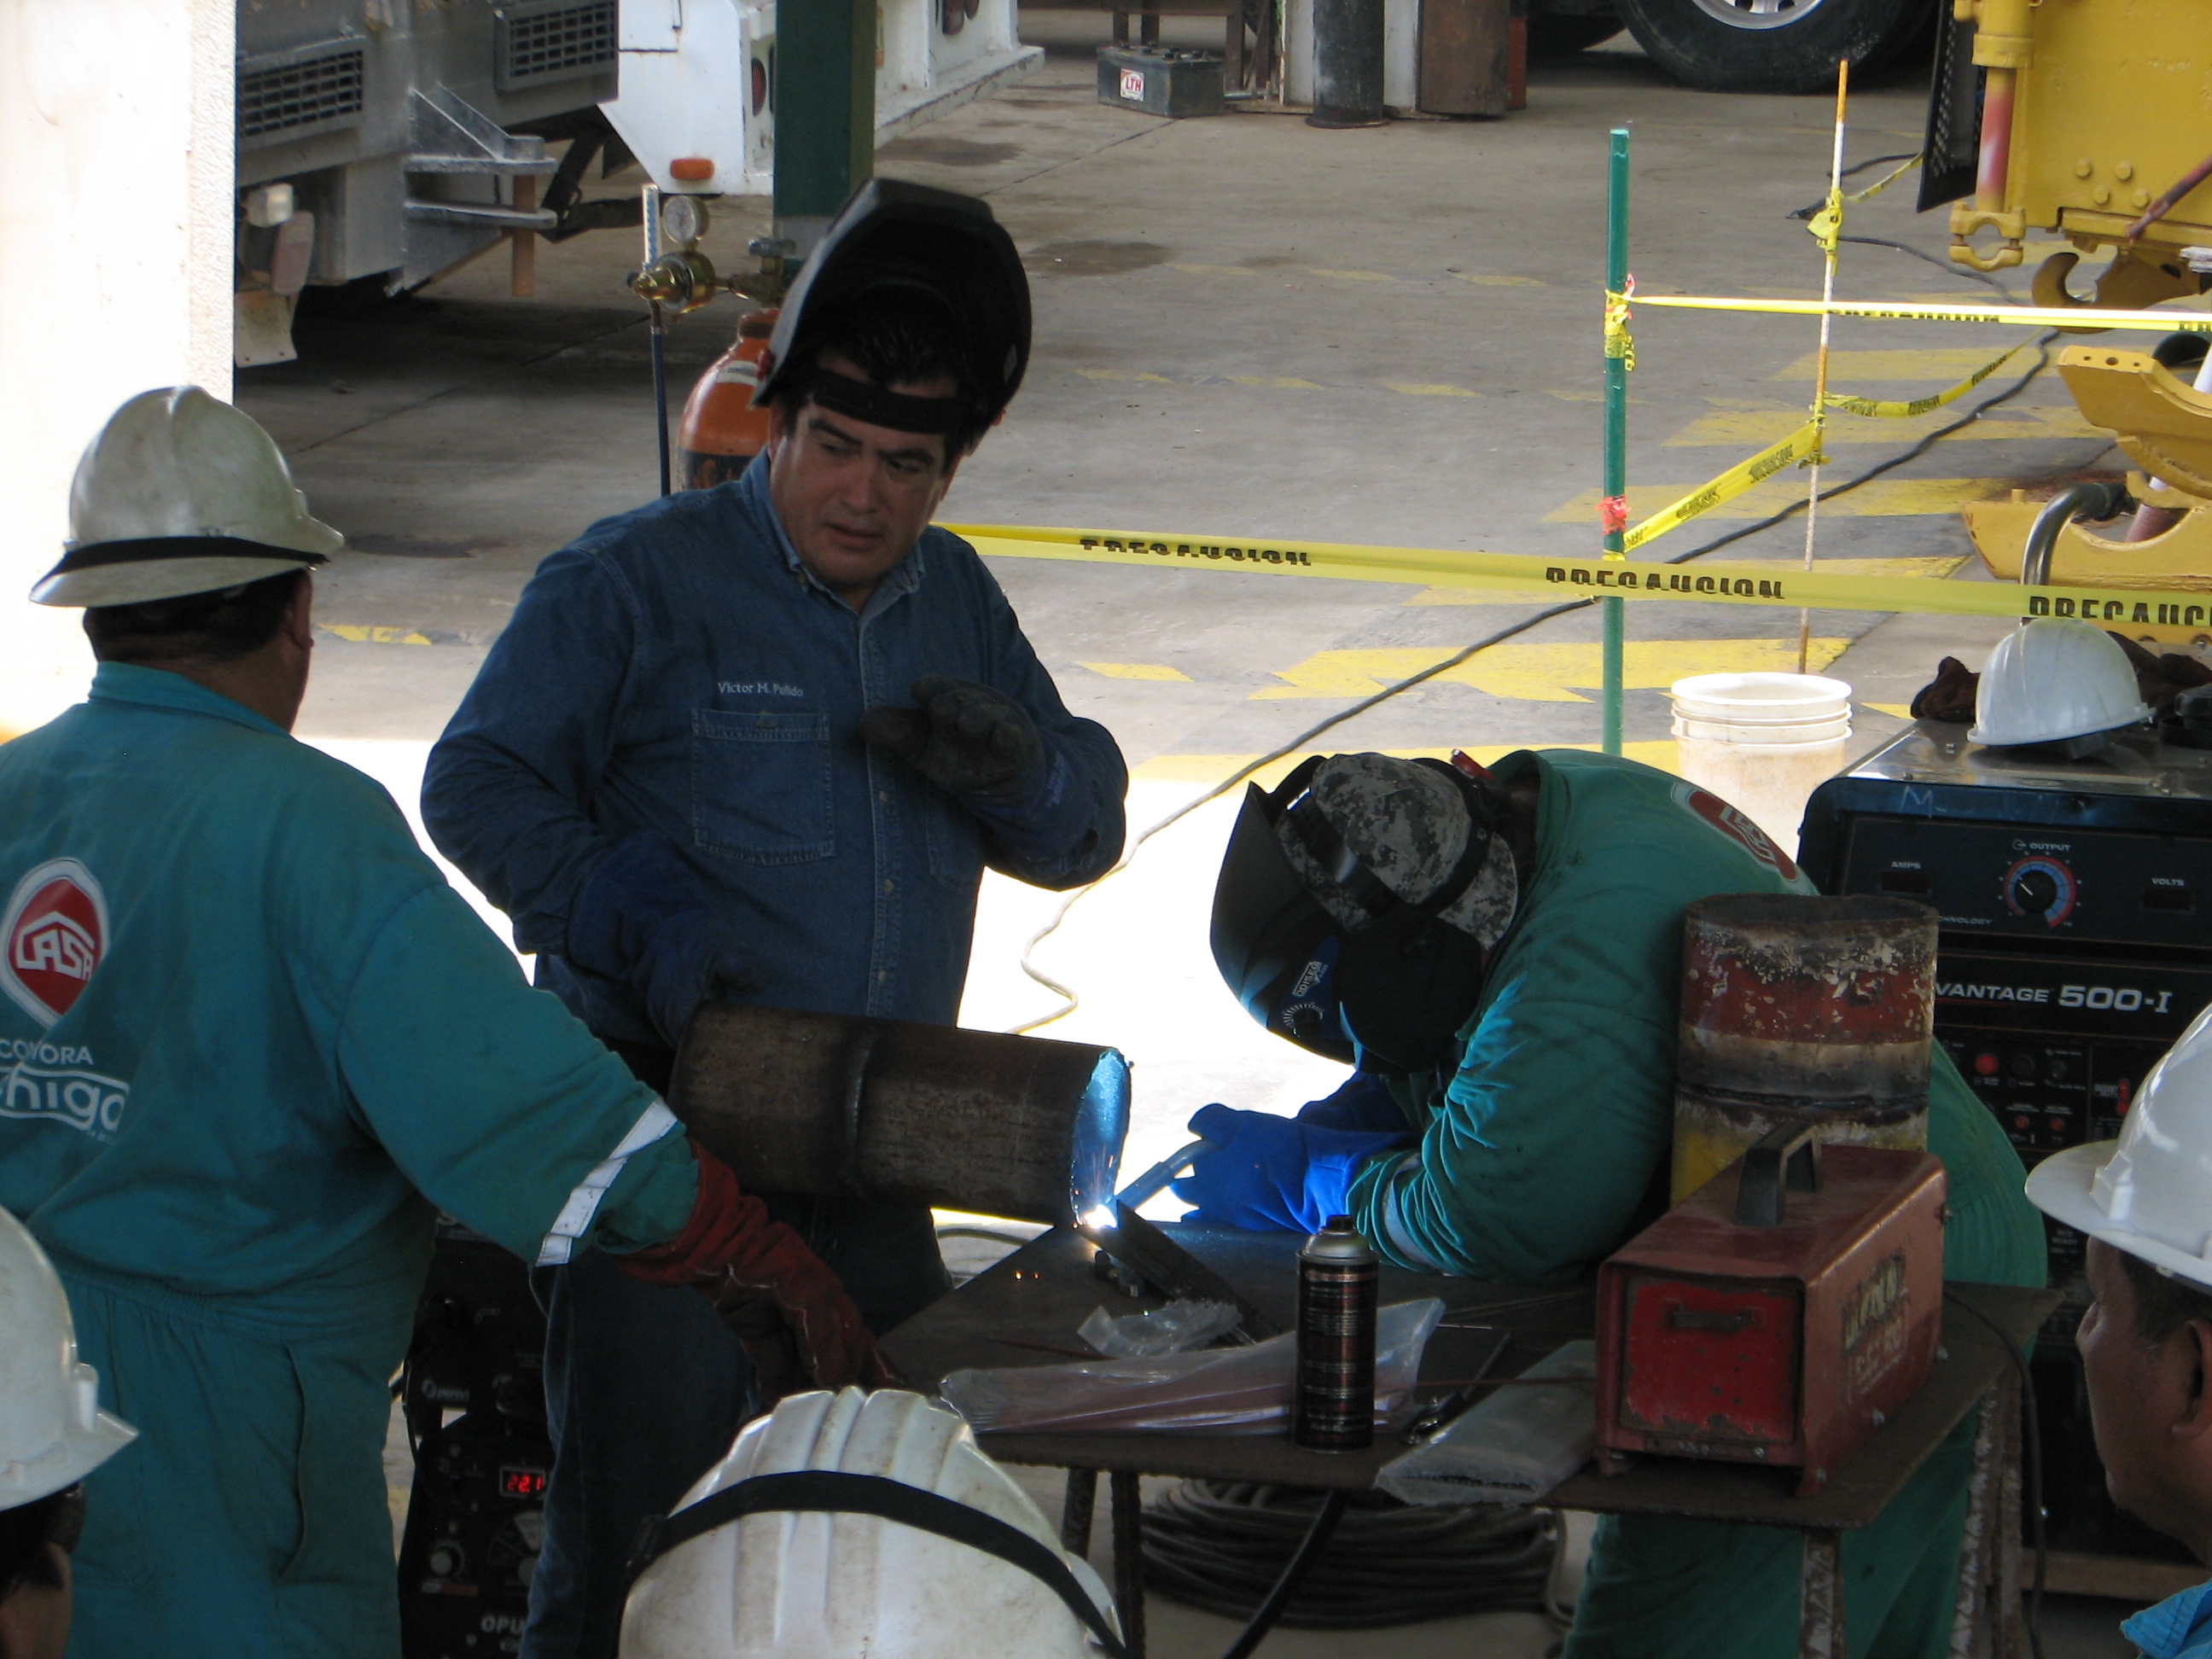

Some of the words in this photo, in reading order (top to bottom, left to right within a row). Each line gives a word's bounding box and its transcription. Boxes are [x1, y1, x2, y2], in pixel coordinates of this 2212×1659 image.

[1126, 77, 1142, 92] LTH
[2029, 595, 2212, 627] PRECAUC
[717, 682, 754, 694] Victor
[2029, 841, 2071, 852] OUTPUT
[1891, 861, 1921, 870] AMPS
[2150, 877, 2185, 887] VOLTS
[480, 1615, 527, 1636] OPU
